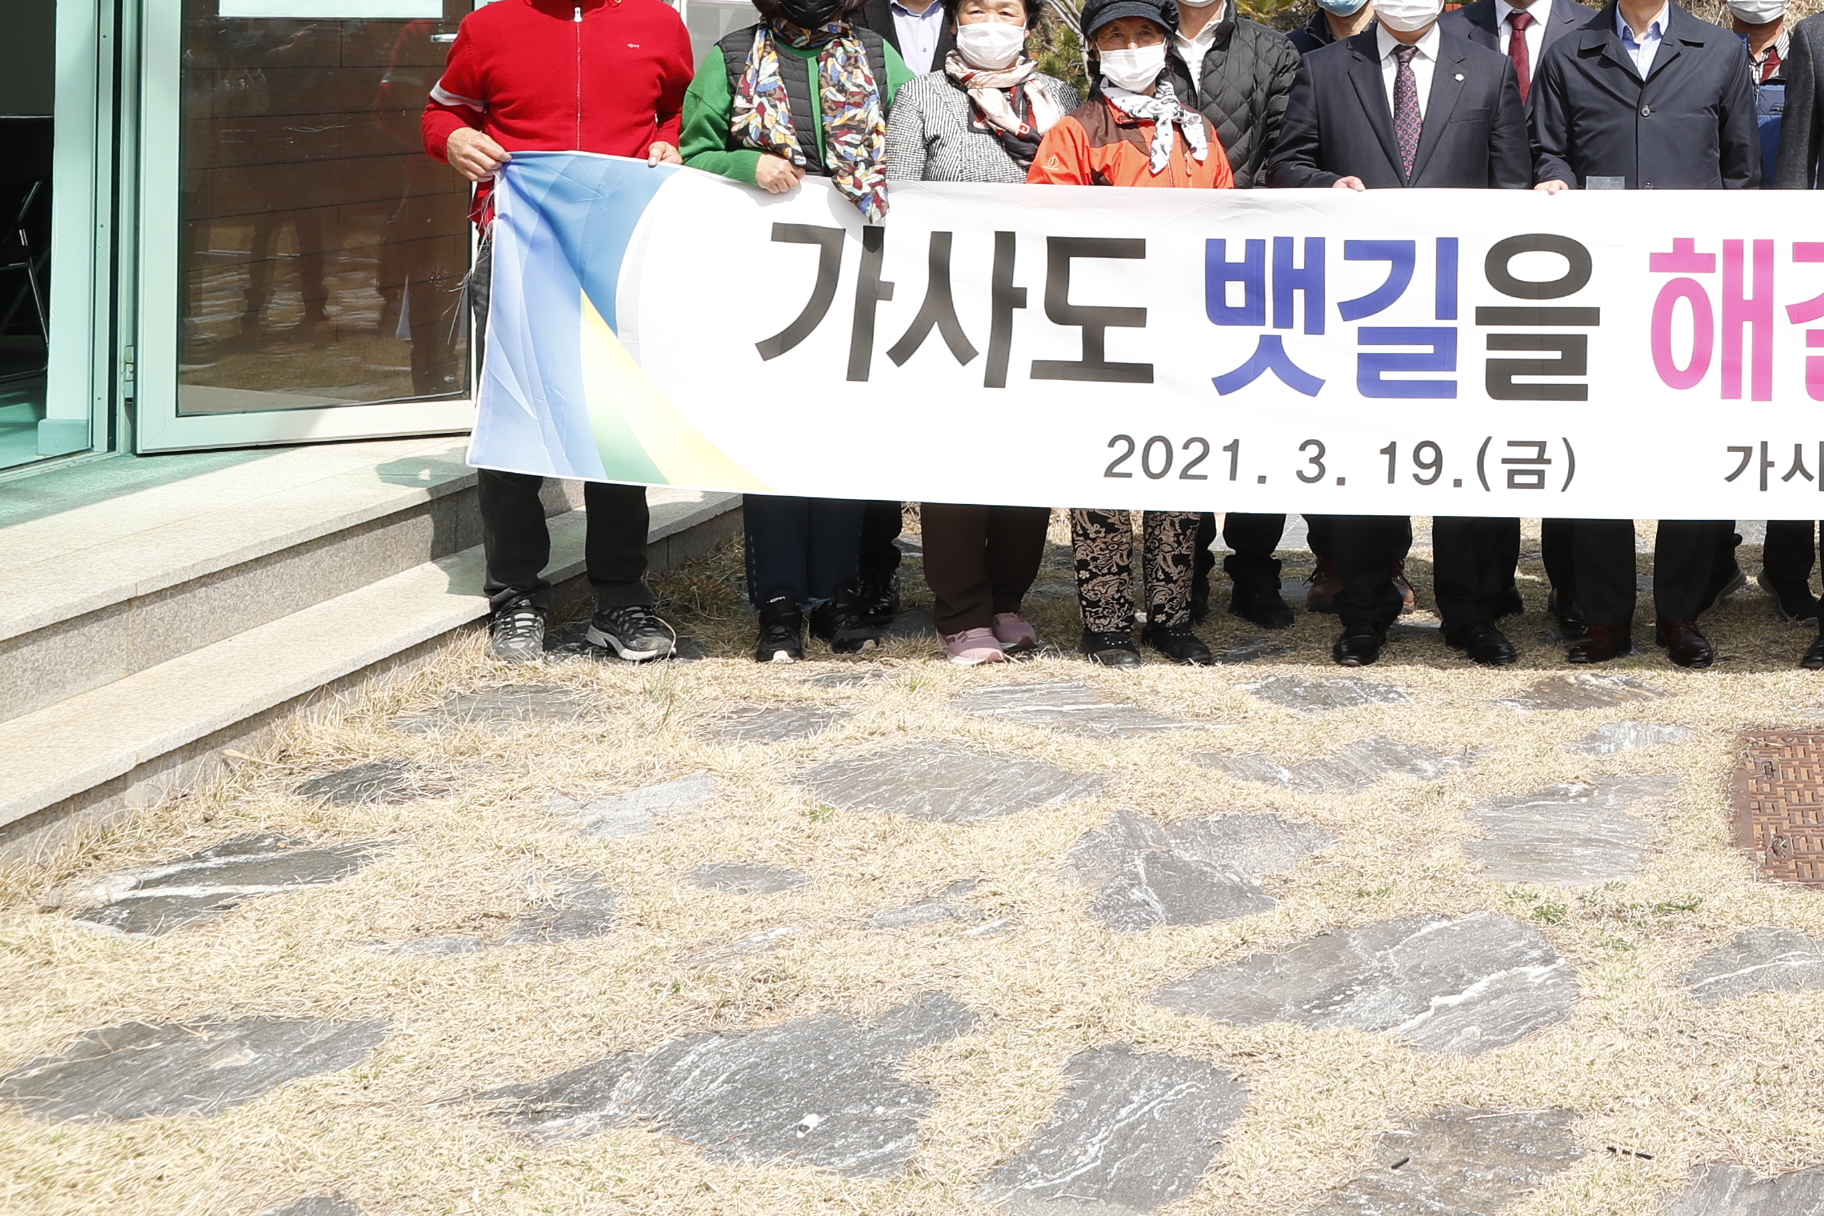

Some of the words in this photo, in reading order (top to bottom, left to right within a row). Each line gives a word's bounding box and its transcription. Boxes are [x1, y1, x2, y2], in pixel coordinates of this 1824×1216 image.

[754, 221, 1155, 389] 가사도
[1203, 232, 1601, 402] 뱃길을
[1102, 433, 1267, 484] 2021.
[1295, 438, 1346, 486] 3.
[1378, 435, 1576, 493] 19.(금)
